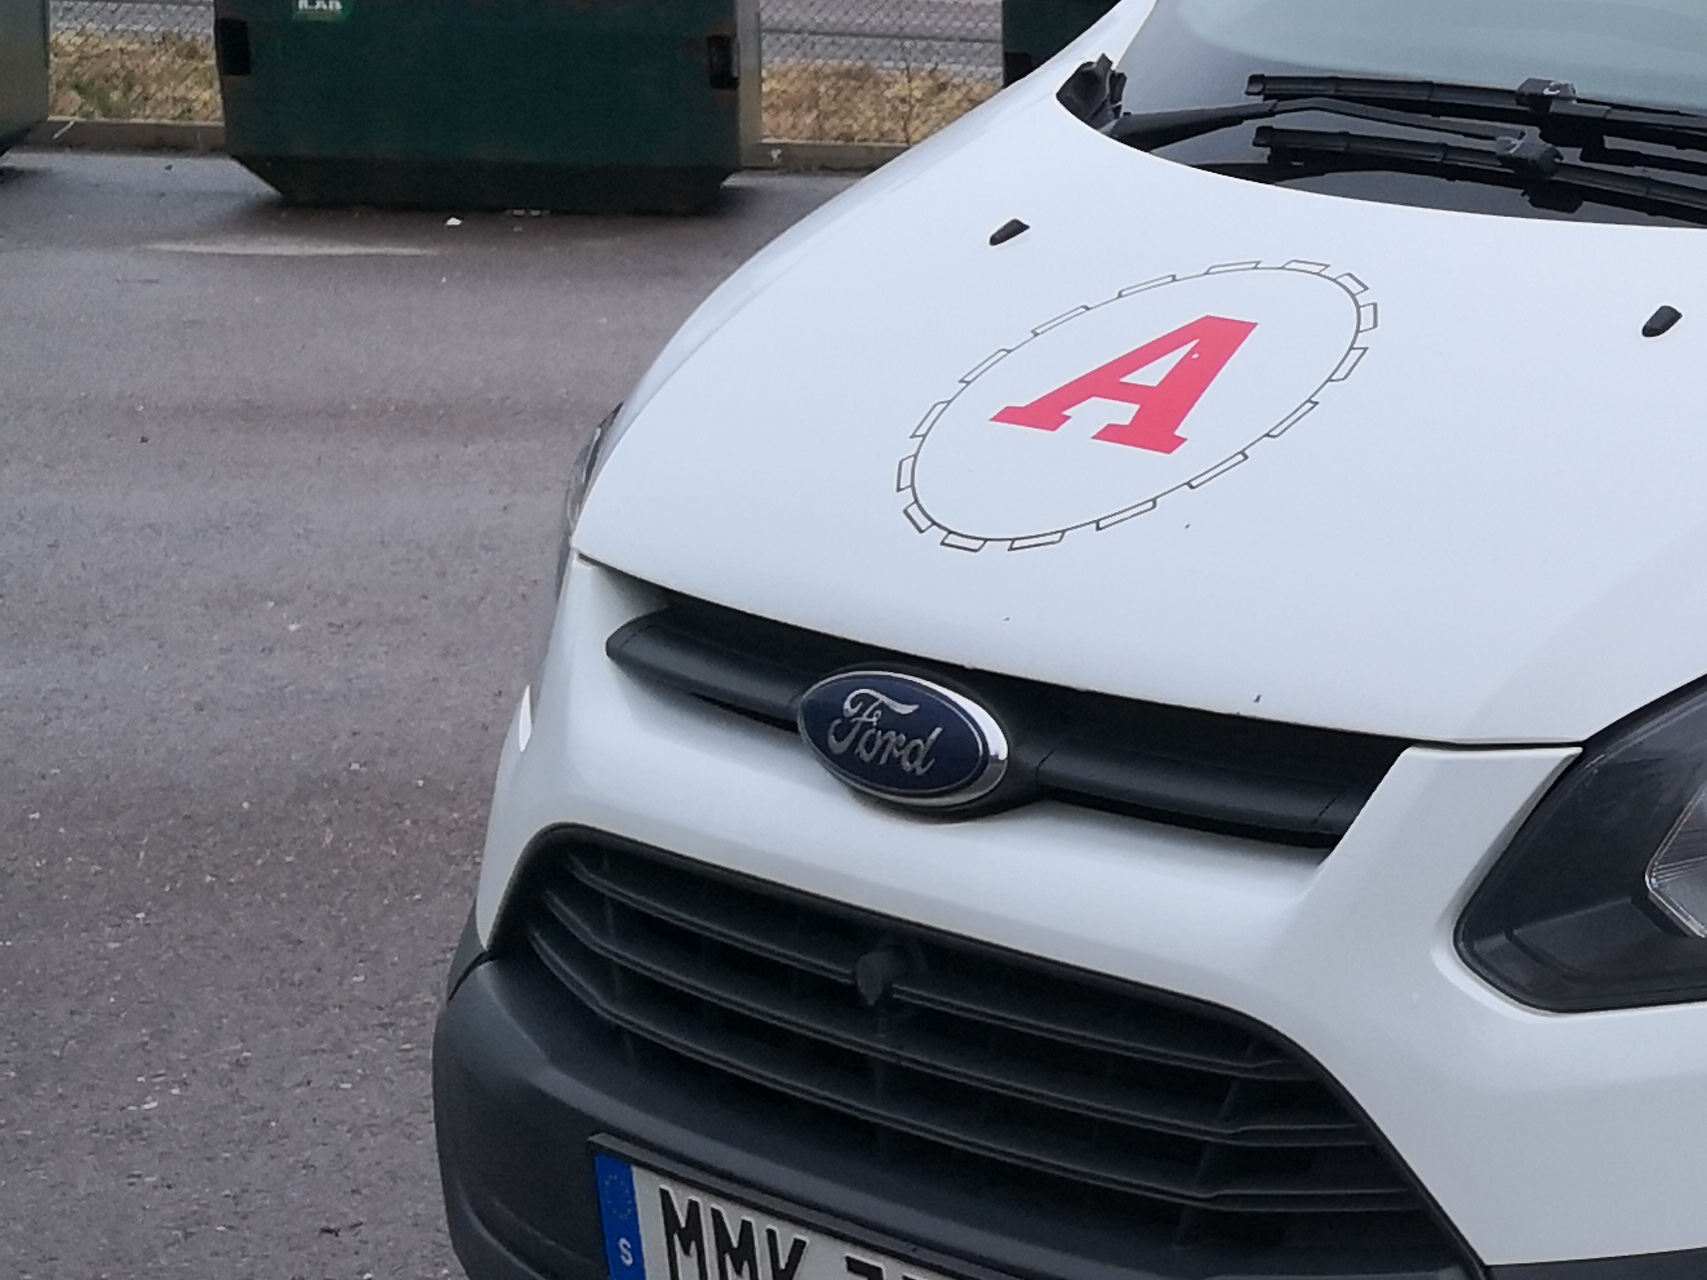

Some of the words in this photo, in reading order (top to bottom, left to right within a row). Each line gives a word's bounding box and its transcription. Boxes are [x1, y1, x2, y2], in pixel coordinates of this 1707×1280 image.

[989, 315, 1258, 454] A
[827, 688, 943, 776] Ford
[618, 1237, 633, 1266] S
